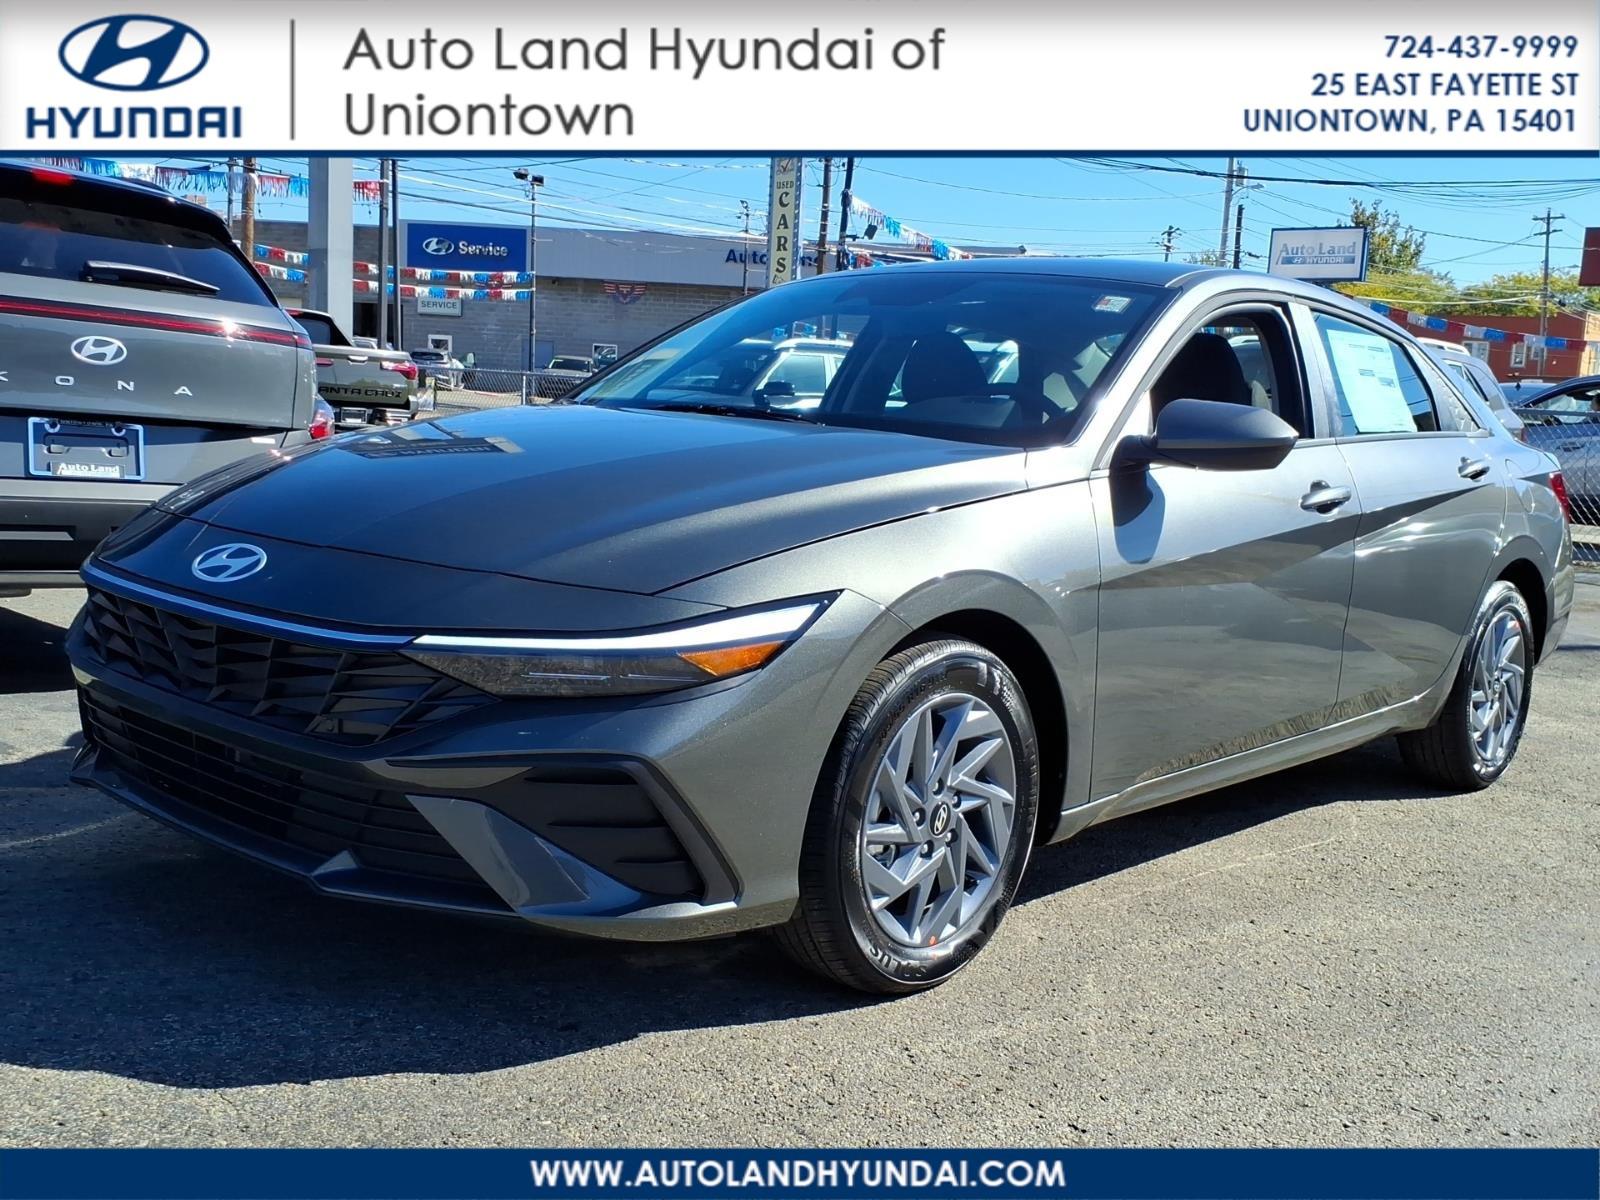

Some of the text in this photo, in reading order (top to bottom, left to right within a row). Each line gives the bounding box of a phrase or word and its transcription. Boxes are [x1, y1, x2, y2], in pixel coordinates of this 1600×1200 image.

[776, 180, 794, 190] USED
[776, 191, 790, 274] CARS
[458, 240, 509, 257] Service
[1279, 242, 1356, 257] Auto Land
[1306, 256, 1345, 265] HYUNDAI
[421, 300, 457, 310] SERVICE
[318, 386, 362, 397] ANTA
[58, 462, 120, 473] Auto Land
